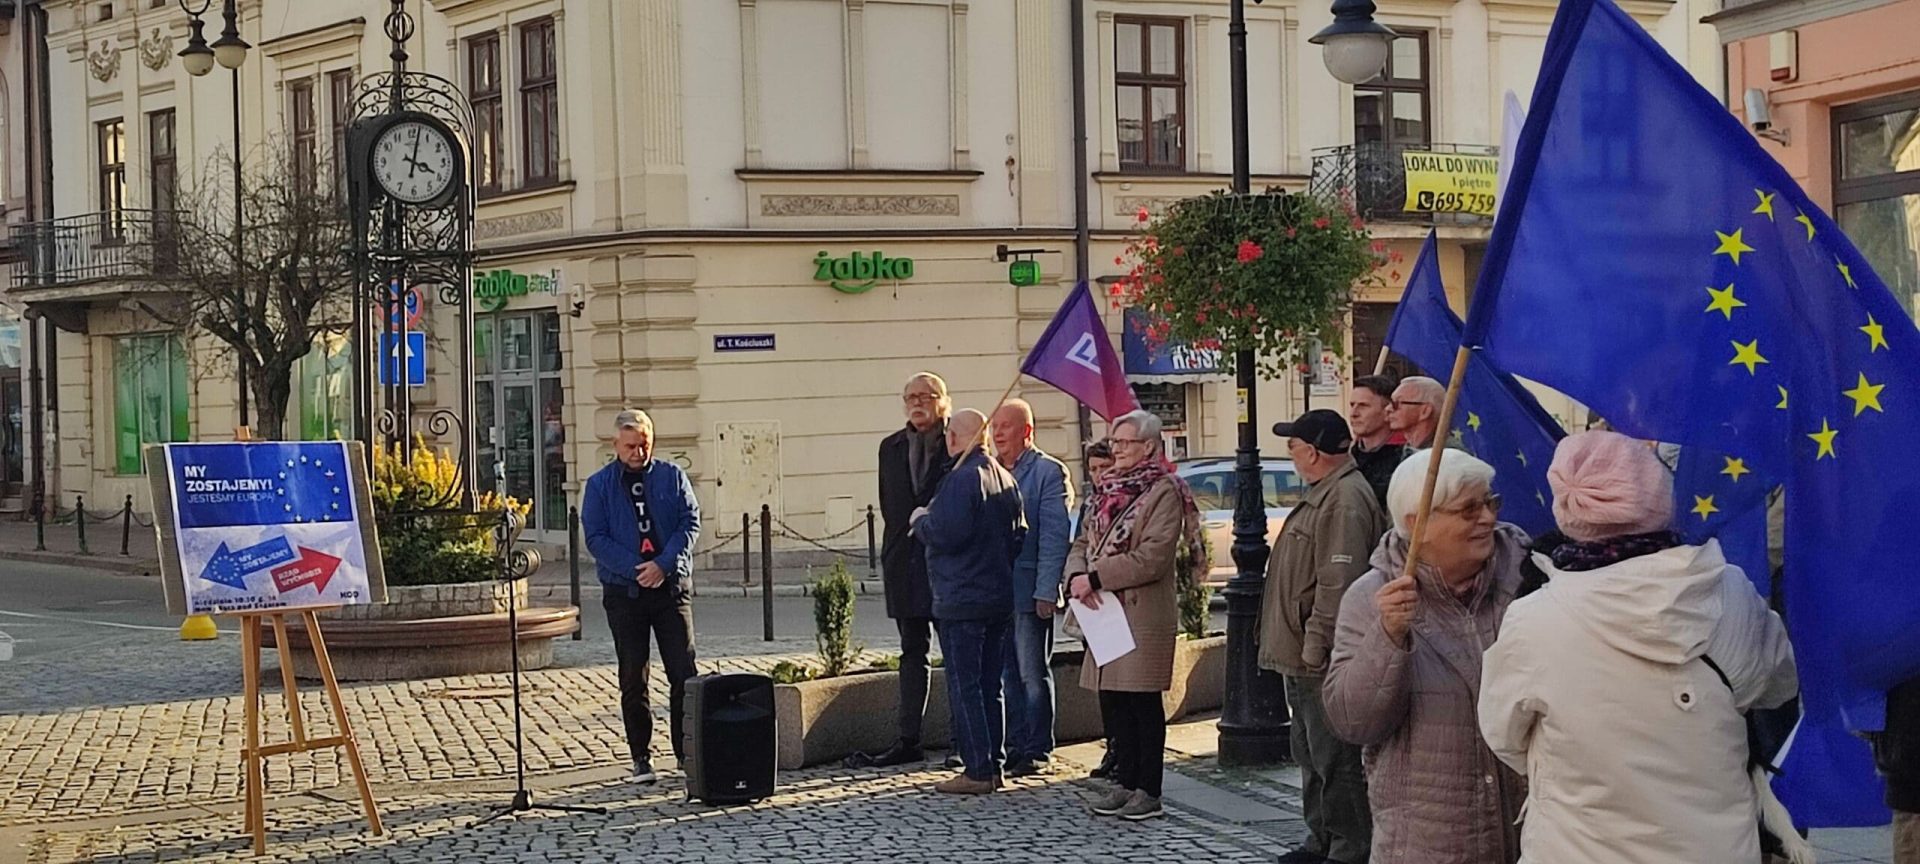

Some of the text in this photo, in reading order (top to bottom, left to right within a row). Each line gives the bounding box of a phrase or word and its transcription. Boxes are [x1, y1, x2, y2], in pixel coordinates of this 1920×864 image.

[1405, 156, 1444, 172] LOKAL
[1445, 158, 1463, 173] DO
[1435, 191, 1496, 213] 695 759
[813, 250, 914, 280] żabka
[184, 465, 207, 478] MY
[185, 478, 274, 492] ZOSTAJEMY!
